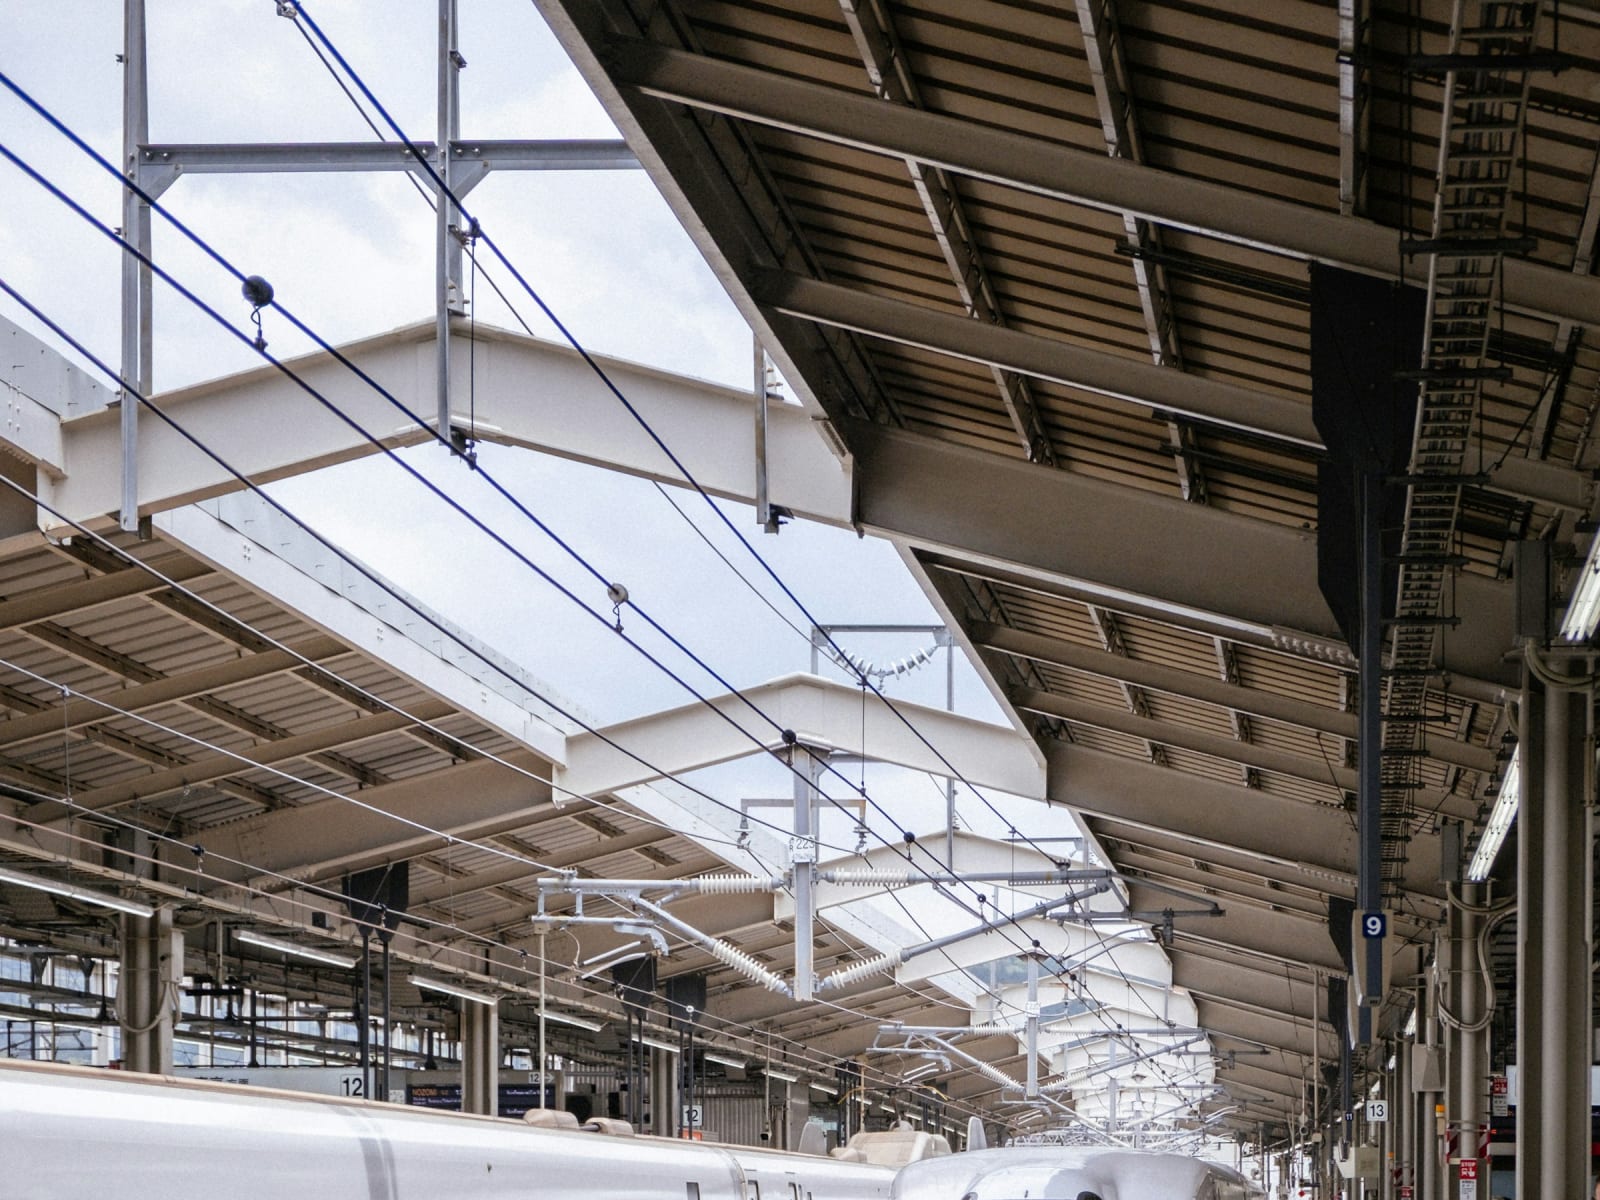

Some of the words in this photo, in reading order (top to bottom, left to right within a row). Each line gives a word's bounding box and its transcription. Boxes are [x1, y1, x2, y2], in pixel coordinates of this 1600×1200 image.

[1366, 916, 1382, 936] 9
[530, 1073, 540, 1083] 12
[342, 1077, 363, 1097] 12
[685, 1109, 699, 1122] 12
[1369, 1104, 1385, 1117] 13
